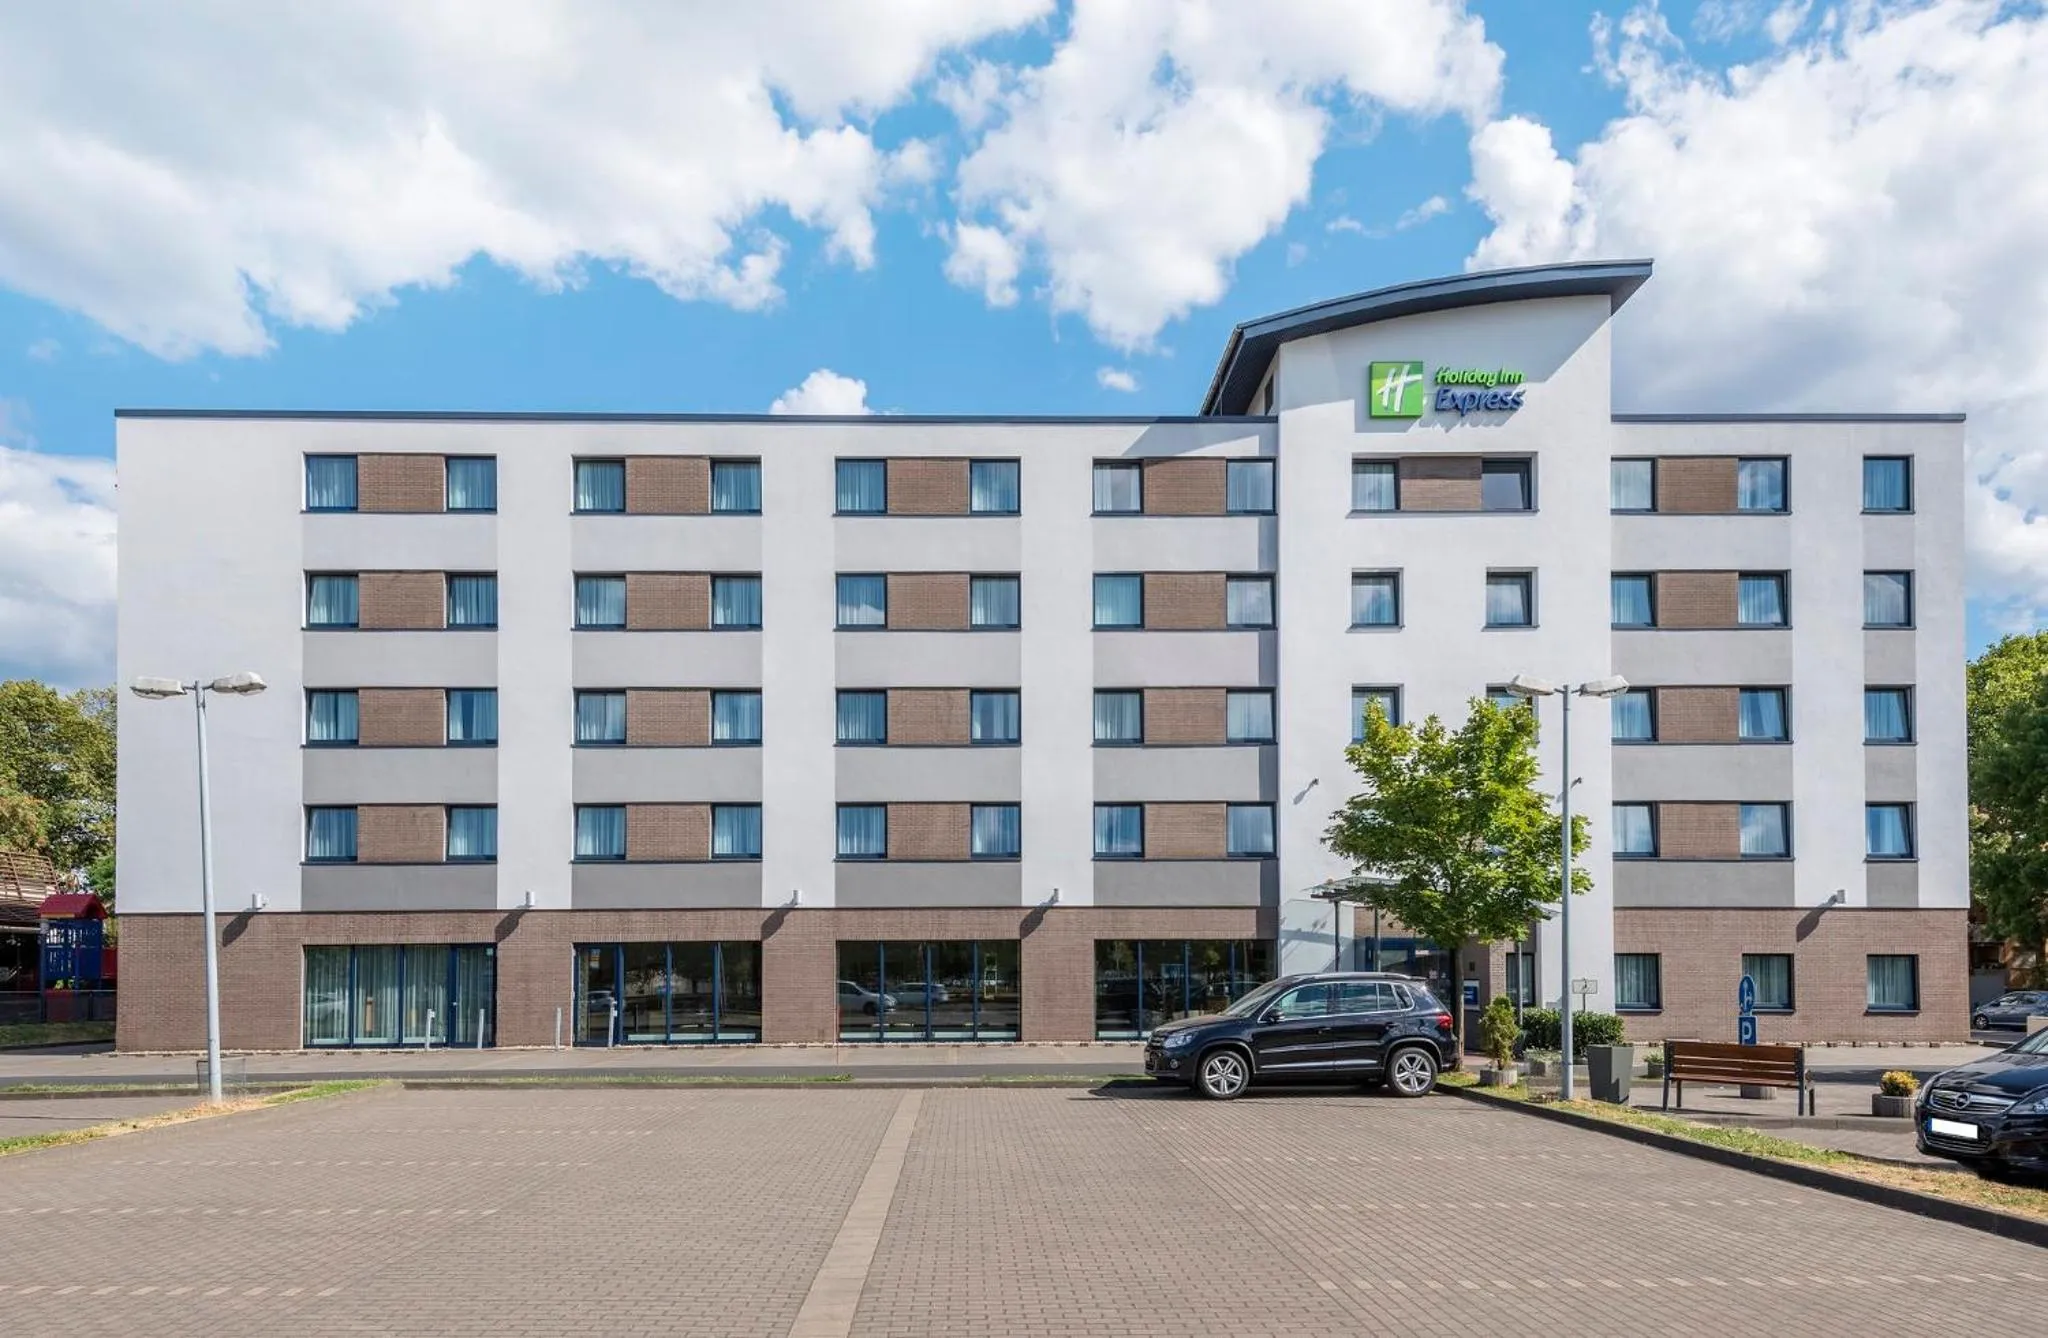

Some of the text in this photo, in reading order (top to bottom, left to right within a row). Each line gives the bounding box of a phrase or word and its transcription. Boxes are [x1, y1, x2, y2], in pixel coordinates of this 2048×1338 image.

[1436, 367, 1526, 387] Holiday Inn
[1436, 388, 1526, 416] Express
[1741, 1021, 1752, 1045] P
